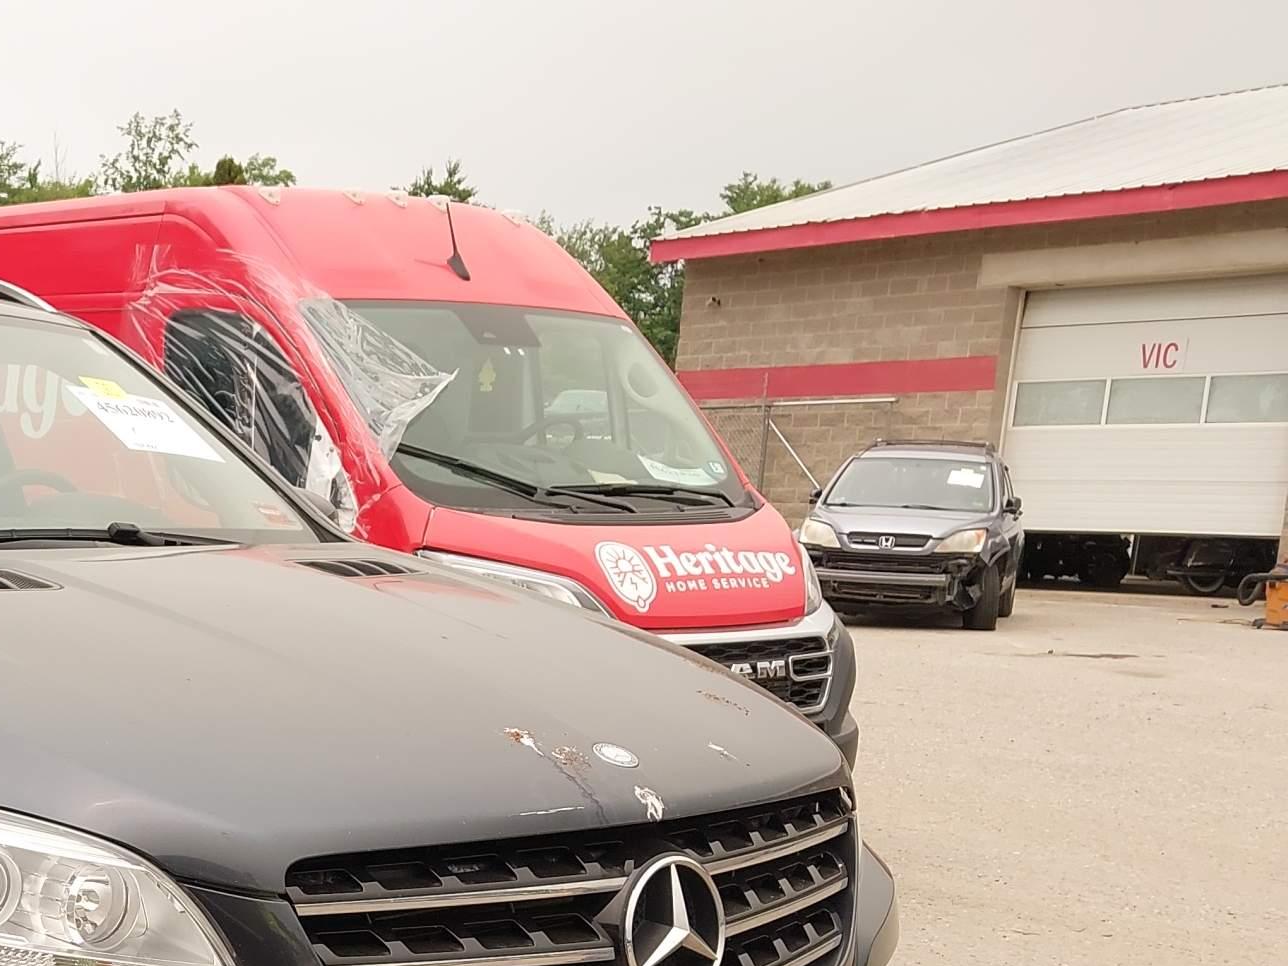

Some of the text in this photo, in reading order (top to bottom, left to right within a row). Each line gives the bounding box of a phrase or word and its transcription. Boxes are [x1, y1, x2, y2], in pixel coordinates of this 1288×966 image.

[1141, 342, 1179, 369] VIC
[644, 543, 796, 582] Heritage
[665, 577, 770, 593] HOME SERVICE
[730, 660, 786, 680] AM
